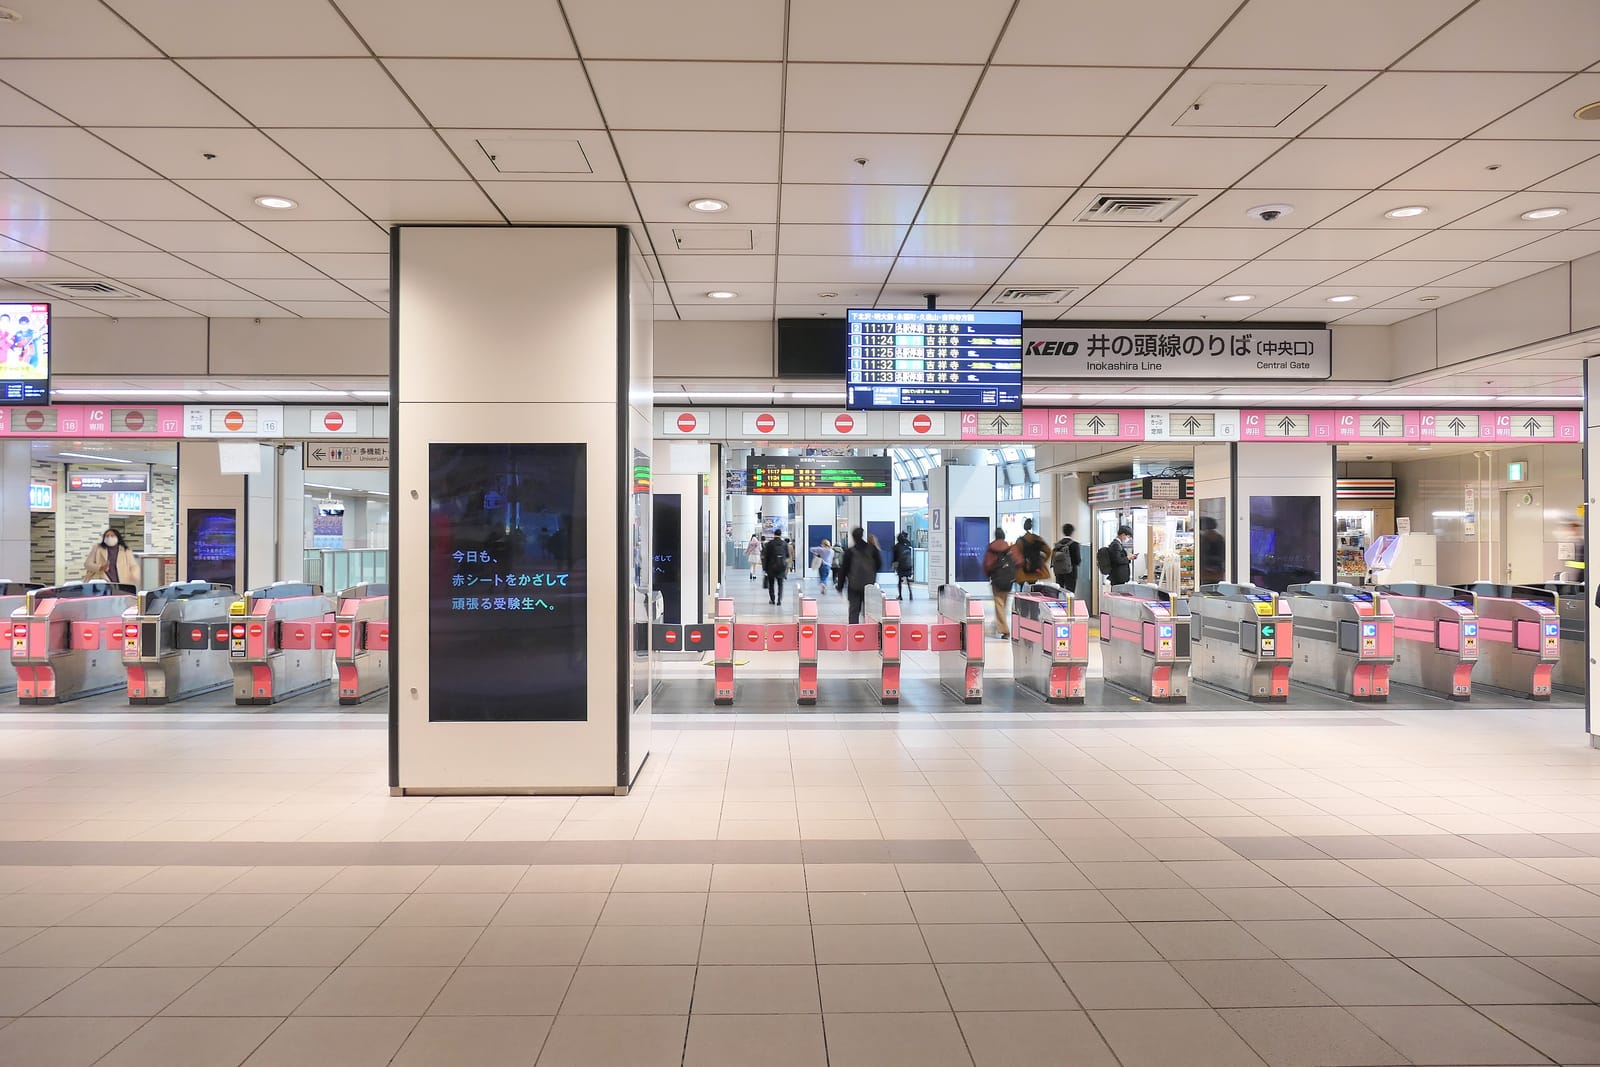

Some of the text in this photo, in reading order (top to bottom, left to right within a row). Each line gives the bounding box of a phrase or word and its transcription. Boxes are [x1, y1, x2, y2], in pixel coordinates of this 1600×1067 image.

[864, 324, 894, 333] 11:17
[864, 336, 894, 345] 11:24
[1025, 341, 1079, 356] KEIO
[1087, 334, 1253, 357] 井の頭線のりば
[864, 348, 894, 357] 11:25
[864, 360, 894, 369] 11:32
[1087, 361, 1310, 371] Inokashira Line Central Gate
[864, 372, 894, 382] 11:33
[90, 410, 104, 420] IC
[963, 414, 975, 423] IC
[1054, 414, 1067, 424] IC
[1246, 415, 1259, 425] IC
[1341, 415, 1354, 425] IC
[1421, 415, 1434, 425] IC
[1497, 415, 1509, 425] IC
[452, 550, 498, 563] 今日も、
[452, 573, 569, 586] 赤シートをかざして
[452, 597, 555, 611] 頑張る受験生へ。
[1057, 626, 1069, 638] IC
[1160, 626, 1172, 637] IC
[1363, 625, 1376, 637] IC
[1464, 624, 1477, 636] IC
[1545, 624, 1558, 636] IC
